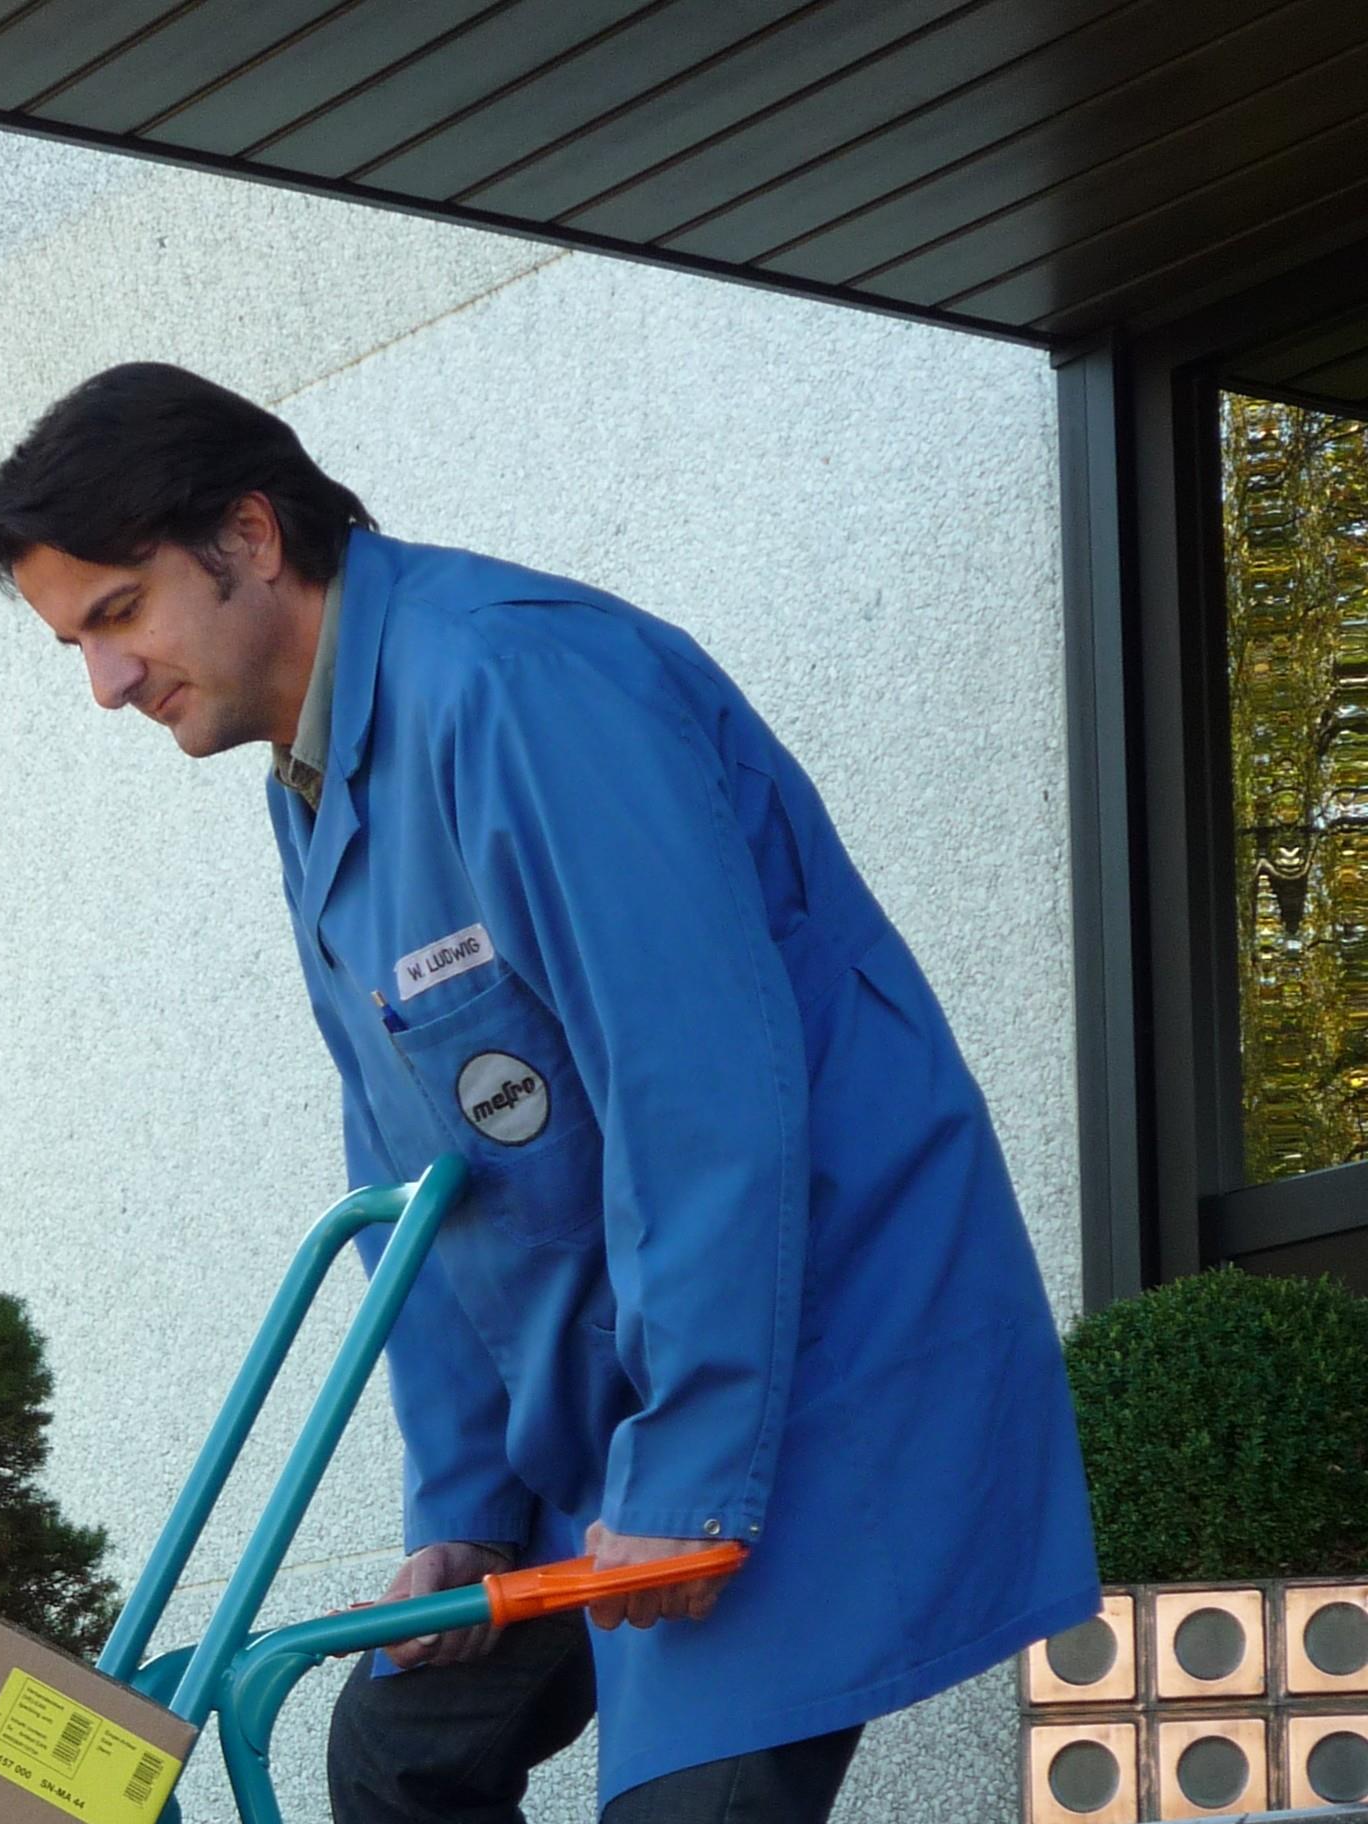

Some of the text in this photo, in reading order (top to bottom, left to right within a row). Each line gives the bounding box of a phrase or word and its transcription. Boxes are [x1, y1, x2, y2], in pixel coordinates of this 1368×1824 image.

[428, 937, 481, 973] LUDWIG
[14, 1764, 32, 1780] 000
[72, 1797, 85, 1809] 44
